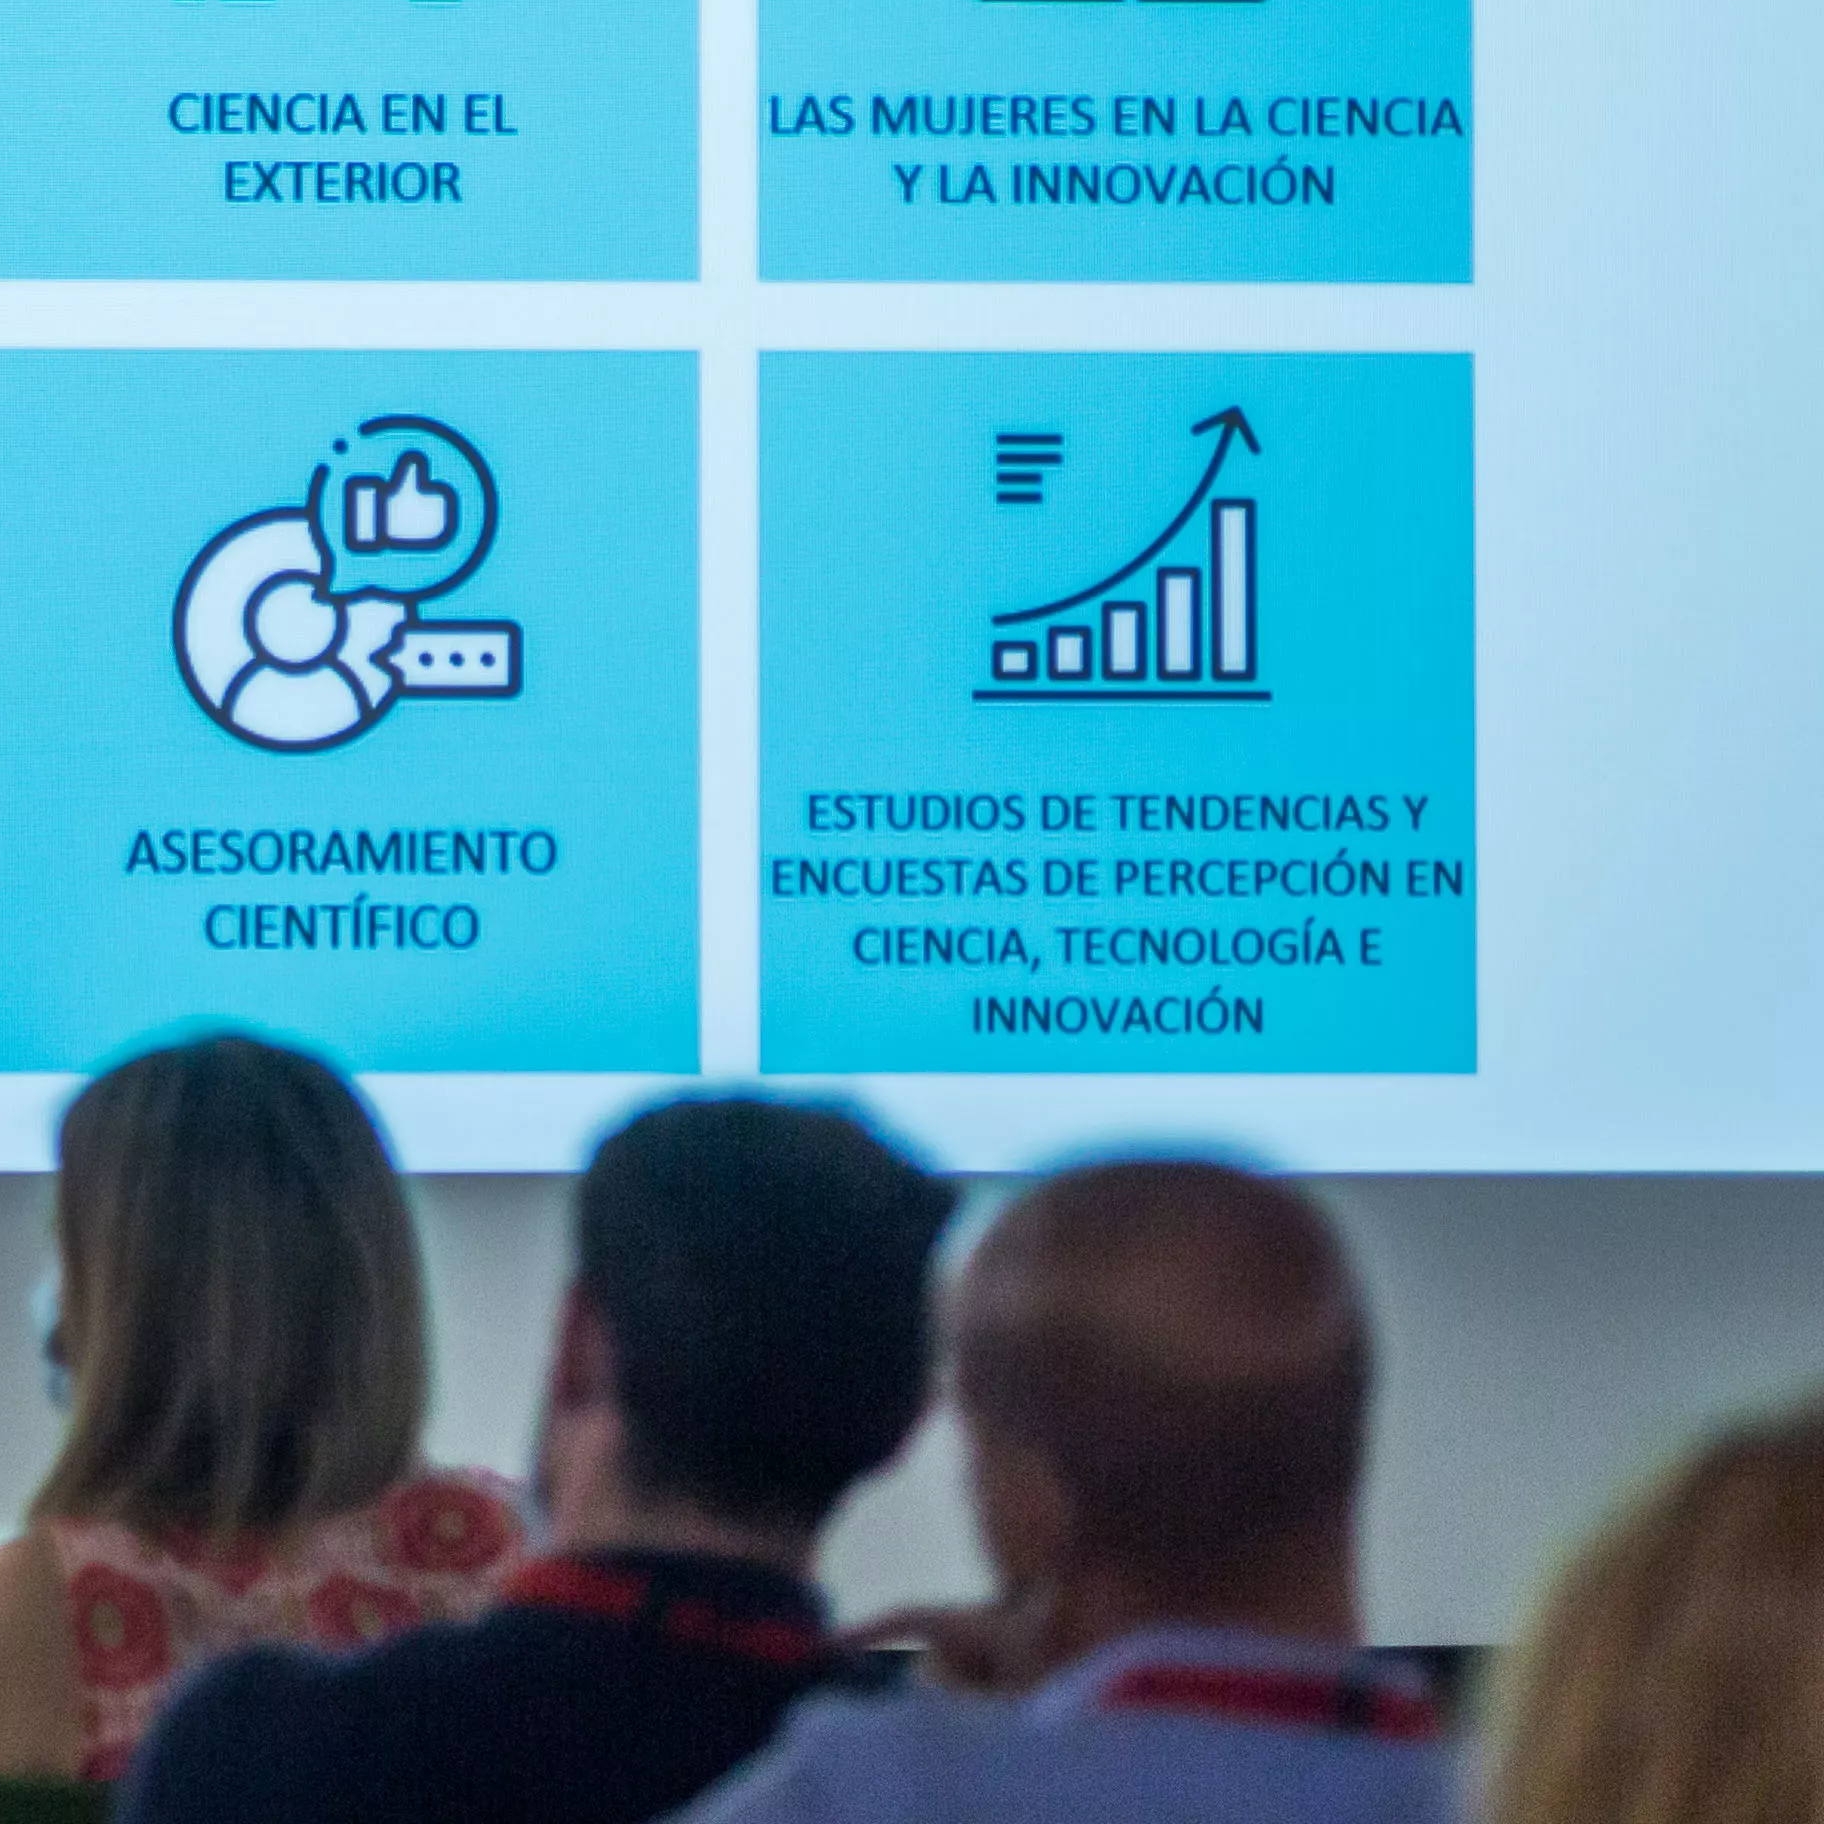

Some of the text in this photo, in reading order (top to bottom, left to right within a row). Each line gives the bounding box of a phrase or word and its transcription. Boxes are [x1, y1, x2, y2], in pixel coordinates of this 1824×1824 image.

[169, 93, 517, 133] CIENCIA EN EL
[771, 95, 1463, 136] LAS MUJERES EN LA CIENCIA
[225, 161, 461, 202] EXTERIOR
[894, 154, 1334, 205] Y LA INNOVACIÓN
[809, 794, 1428, 831] ESTUDIOS DE TENDENCIAS Y
[126, 830, 557, 874] ASESORAMIENTO
[773, 848, 1462, 896] ENCUESTAS DE PERCEPCIÓN EN
[205, 894, 478, 948] CIENTÍFICO
[853, 916, 1381, 973] CIENCIA, TECNOLOGÍA E
[973, 985, 1263, 1034] INNOVACIÓN
